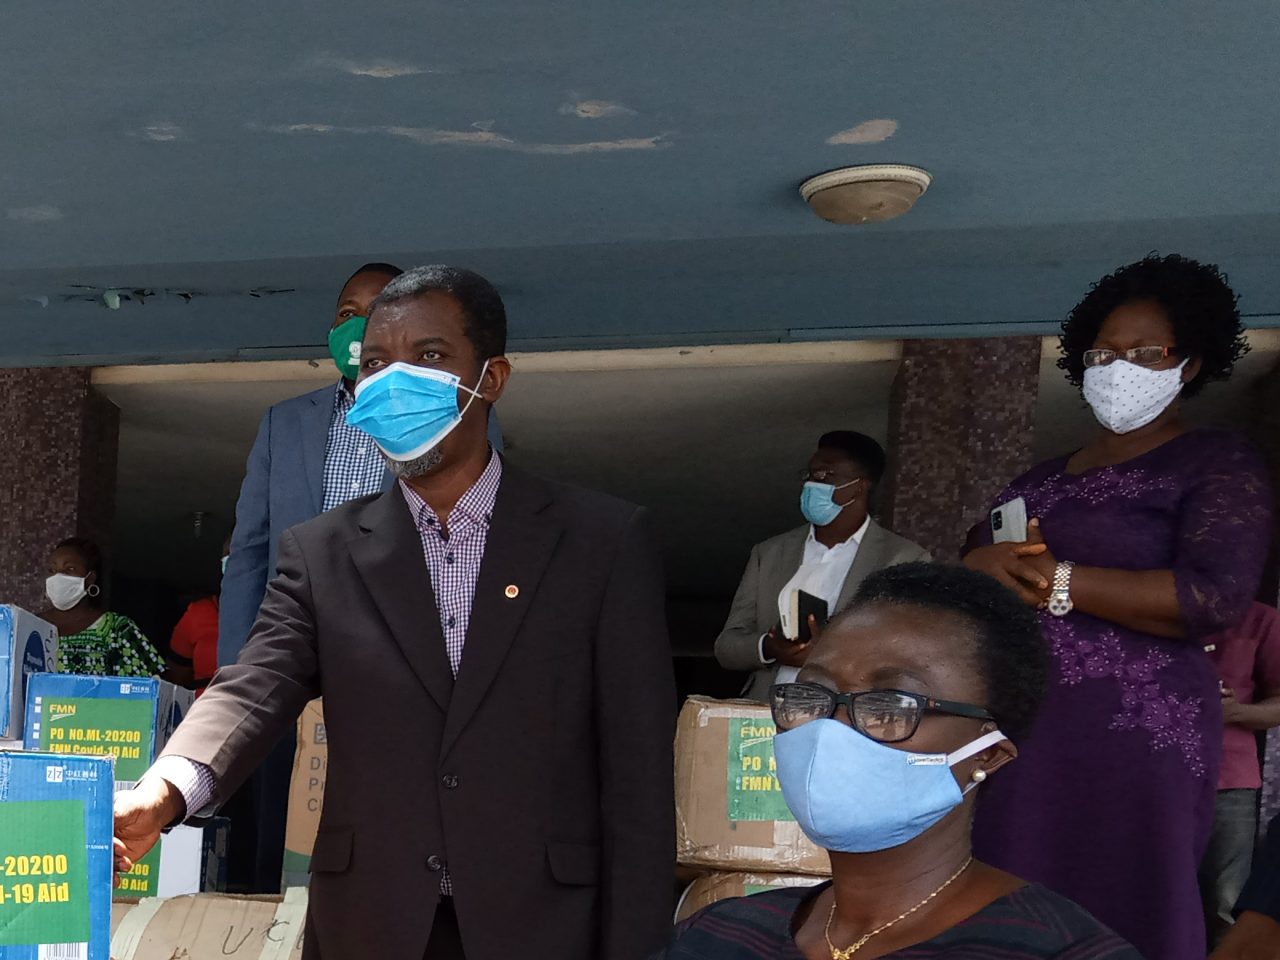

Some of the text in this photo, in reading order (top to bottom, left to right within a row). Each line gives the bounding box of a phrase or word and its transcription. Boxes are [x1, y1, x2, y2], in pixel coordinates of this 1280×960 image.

[50, 704, 76, 714] FMN
[50, 728, 64, 740] PO
[741, 726, 776, 738] FMN
[121, 746, 139, 759] Aid
[742, 756, 761, 771] PO
[741, 776, 772, 791] FMN
[130, 879, 148, 891] Aid
[38, 882, 69, 903] Aid
